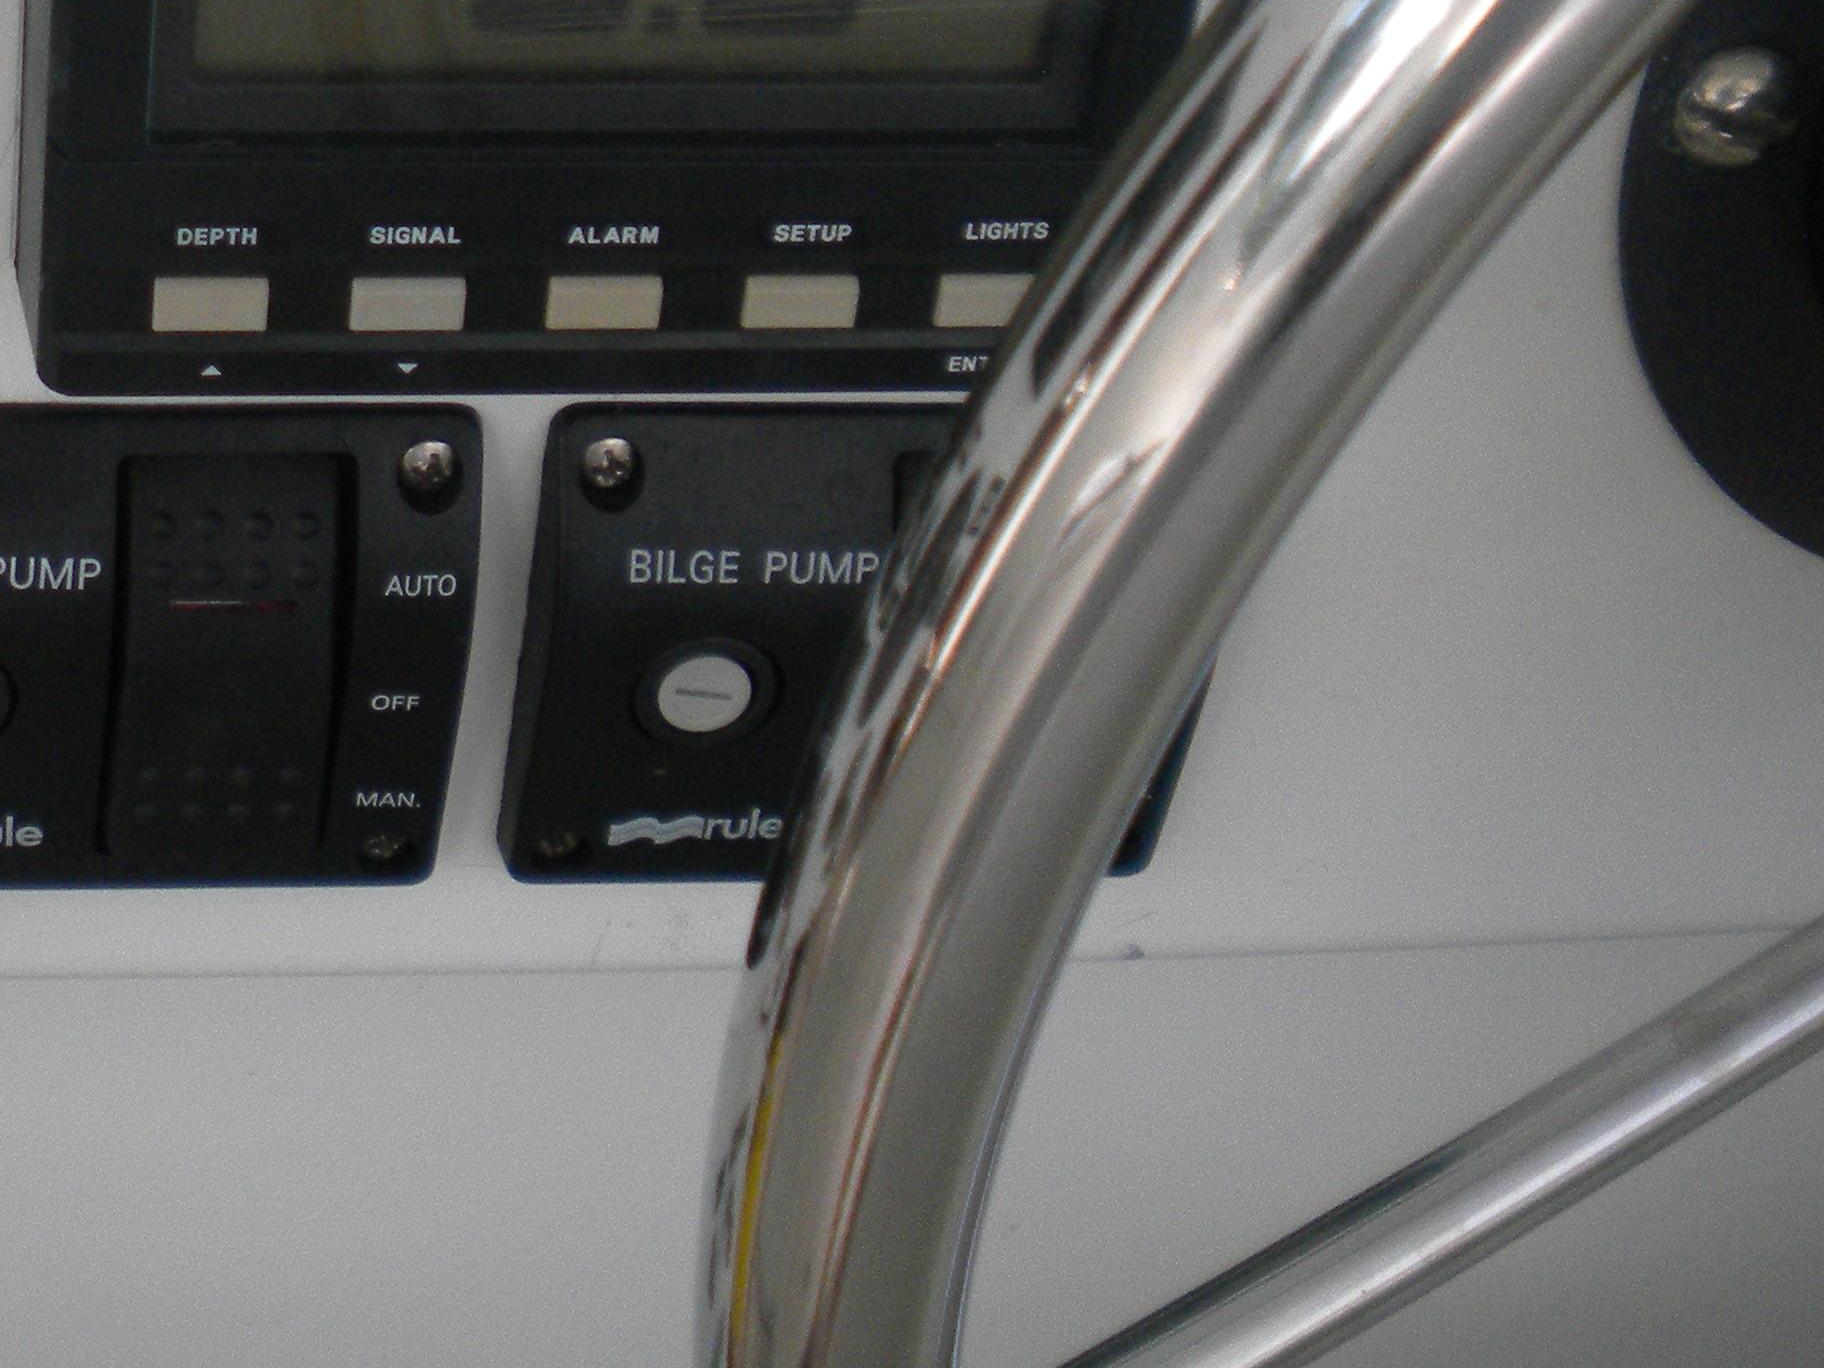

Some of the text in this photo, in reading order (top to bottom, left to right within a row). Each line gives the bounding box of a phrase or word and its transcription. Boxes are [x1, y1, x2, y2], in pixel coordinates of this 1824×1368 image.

[176, 227, 258, 246] DEPTH
[369, 226, 461, 245] SIGNAL
[568, 226, 660, 245] ALARM
[773, 224, 853, 243] SETUP
[965, 221, 1049, 241] LIGHTS
[629, 548, 880, 585] BILGE PUMP
[384, 573, 457, 597] AUTO
[370, 694, 420, 711] OFF
[355, 790, 422, 809] MAN.
[702, 807, 783, 840] rule
